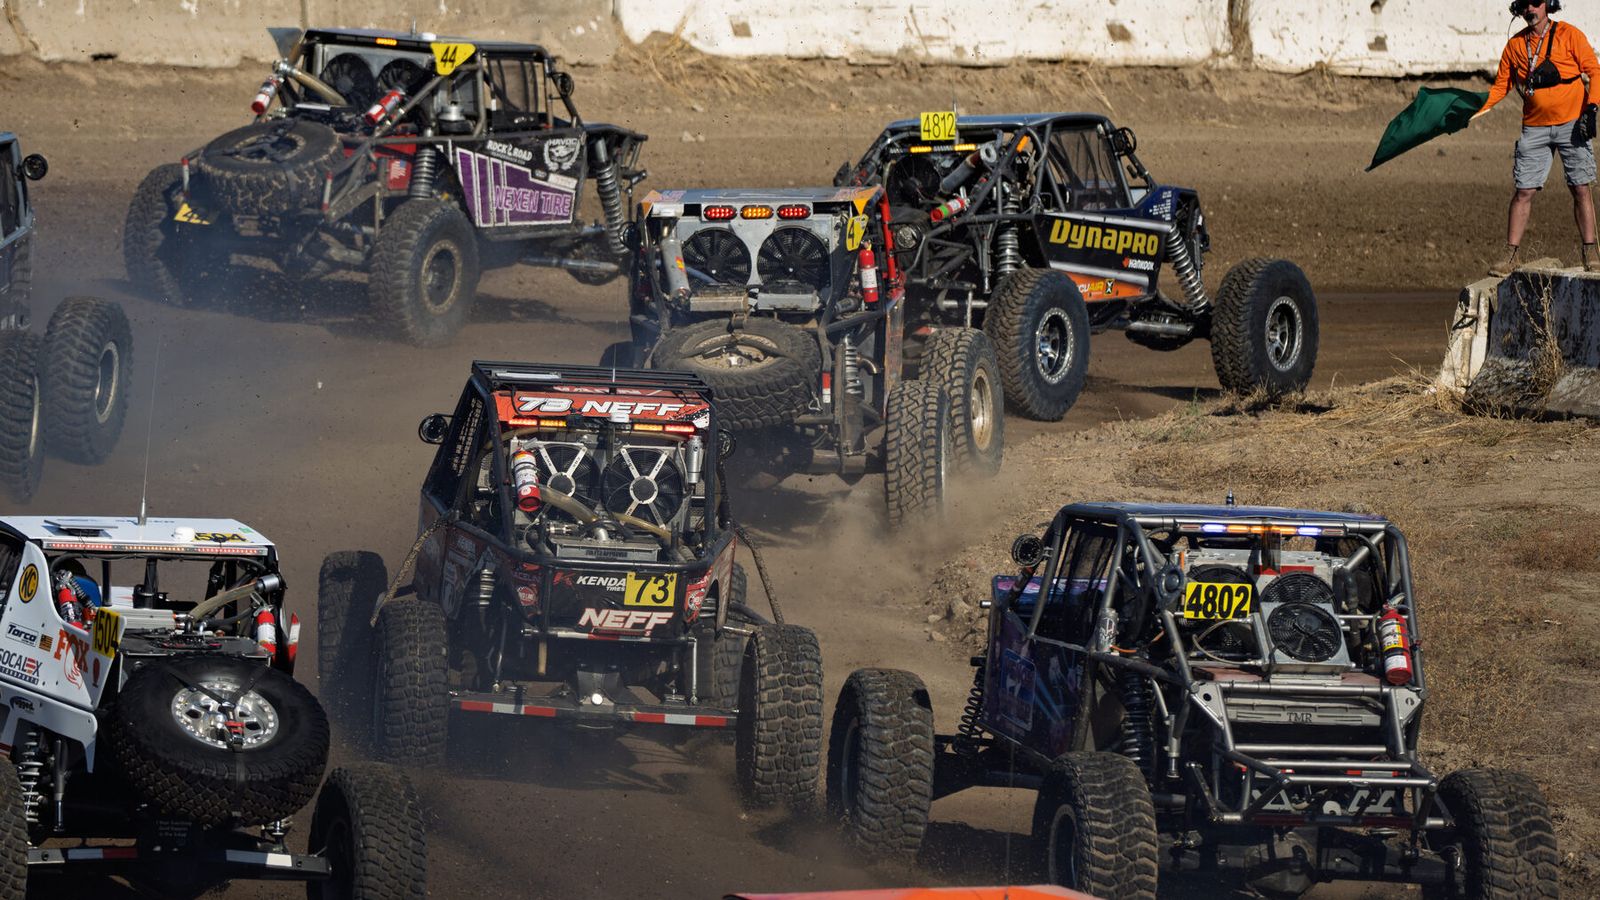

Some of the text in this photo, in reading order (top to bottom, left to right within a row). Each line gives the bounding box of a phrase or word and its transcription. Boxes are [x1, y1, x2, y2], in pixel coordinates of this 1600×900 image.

[440, 45, 458, 68] 44
[922, 113, 956, 139] 4812
[487, 140, 508, 153] ROCK
[513, 147, 533, 162] ROAD
[495, 186, 572, 216] NEXEN TIRE
[518, 396, 685, 416] 73 NEFF
[22, 568, 36, 598] KC
[576, 575, 626, 587] KENDA
[634, 575, 670, 604] 73
[1186, 584, 1249, 619] 4802
[578, 607, 674, 629] NEFF
[93, 610, 119, 654] 1504
[54, 629, 90, 673] FOX
[1286, 712, 1312, 723] TMR
